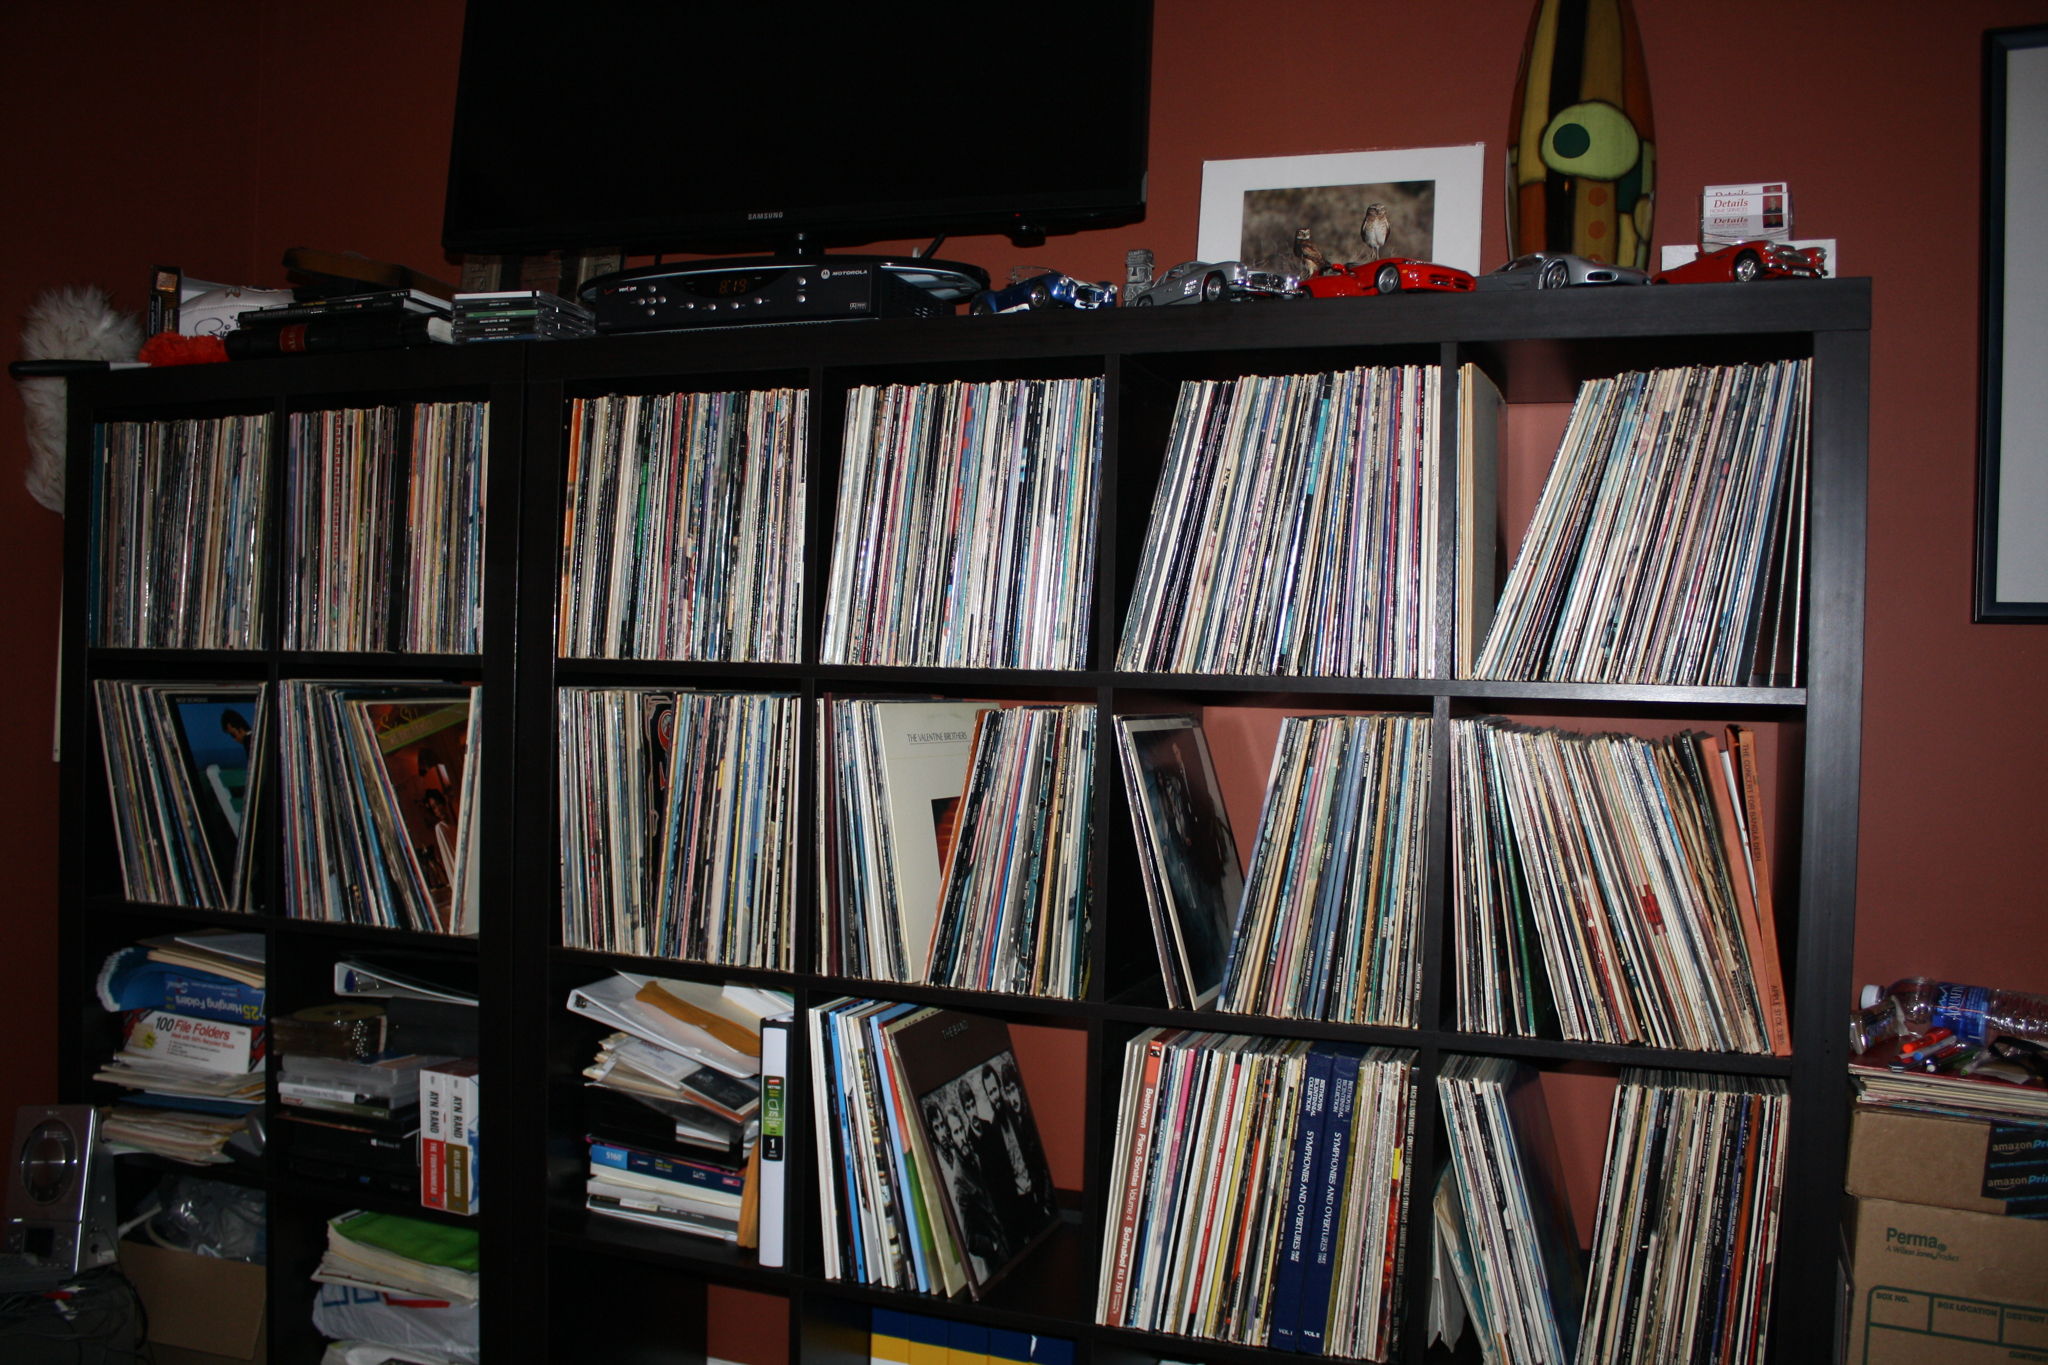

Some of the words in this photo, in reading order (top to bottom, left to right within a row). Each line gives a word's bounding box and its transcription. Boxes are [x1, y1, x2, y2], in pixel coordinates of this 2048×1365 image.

[1714, 198, 1748, 208] Details
[747, 211, 784, 220] SAMSUNG
[832, 269, 868, 277] MOTOROLA
[907, 733, 918, 743] THE
[918, 732, 944, 742] VALENTINE
[944, 731, 968, 740] BROTHERS
[1742, 744, 1750, 758] THE
[1744, 760, 1752, 793] CONCERT
[1748, 796, 1756, 810] FOR
[1750, 812, 1759, 841] BANGLA
[1753, 842, 1761, 862] DESH
[1770, 985, 1780, 1006] APPLE
[206, 998, 242, 1014] Hanging
[243, 1004, 260, 1021] 25
[156, 1016, 174, 1032] 100
[174, 1020, 192, 1033] File
[193, 1023, 231, 1041] Folders
[430, 1091, 439, 1108] AYN
[454, 1096, 462, 1112] AYN
[1140, 1088, 1154, 1128] Beethoven
[430, 1110, 439, 1134] RAND
[454, 1116, 463, 1138] RAND
[770, 1138, 776, 1149] 1
[1136, 1133, 1146, 1156] Piano
[1301, 1130, 1314, 1184] SYMPHONIES
[1328, 1132, 1342, 1184] SYMPHONIES
[1130, 1156, 1143, 1187] Sonatas
[1126, 1188, 1138, 1215] Volume
[1298, 1184, 1308, 1204] AND
[1326, 1185, 1335, 1205] AND
[1292, 1204, 1305, 1250] OVERTURES
[1320, 1206, 1333, 1252] OVERTURES
[1118, 1226, 1132, 1268] Schnabel
[1886, 1228, 1938, 1248] Perma
[1876, 1292, 1892, 1301] BOX
[1894, 1294, 1909, 1303] NO.
[1937, 1302, 1954, 1310] BOX
[1956, 1304, 1998, 1316] LOCATION
